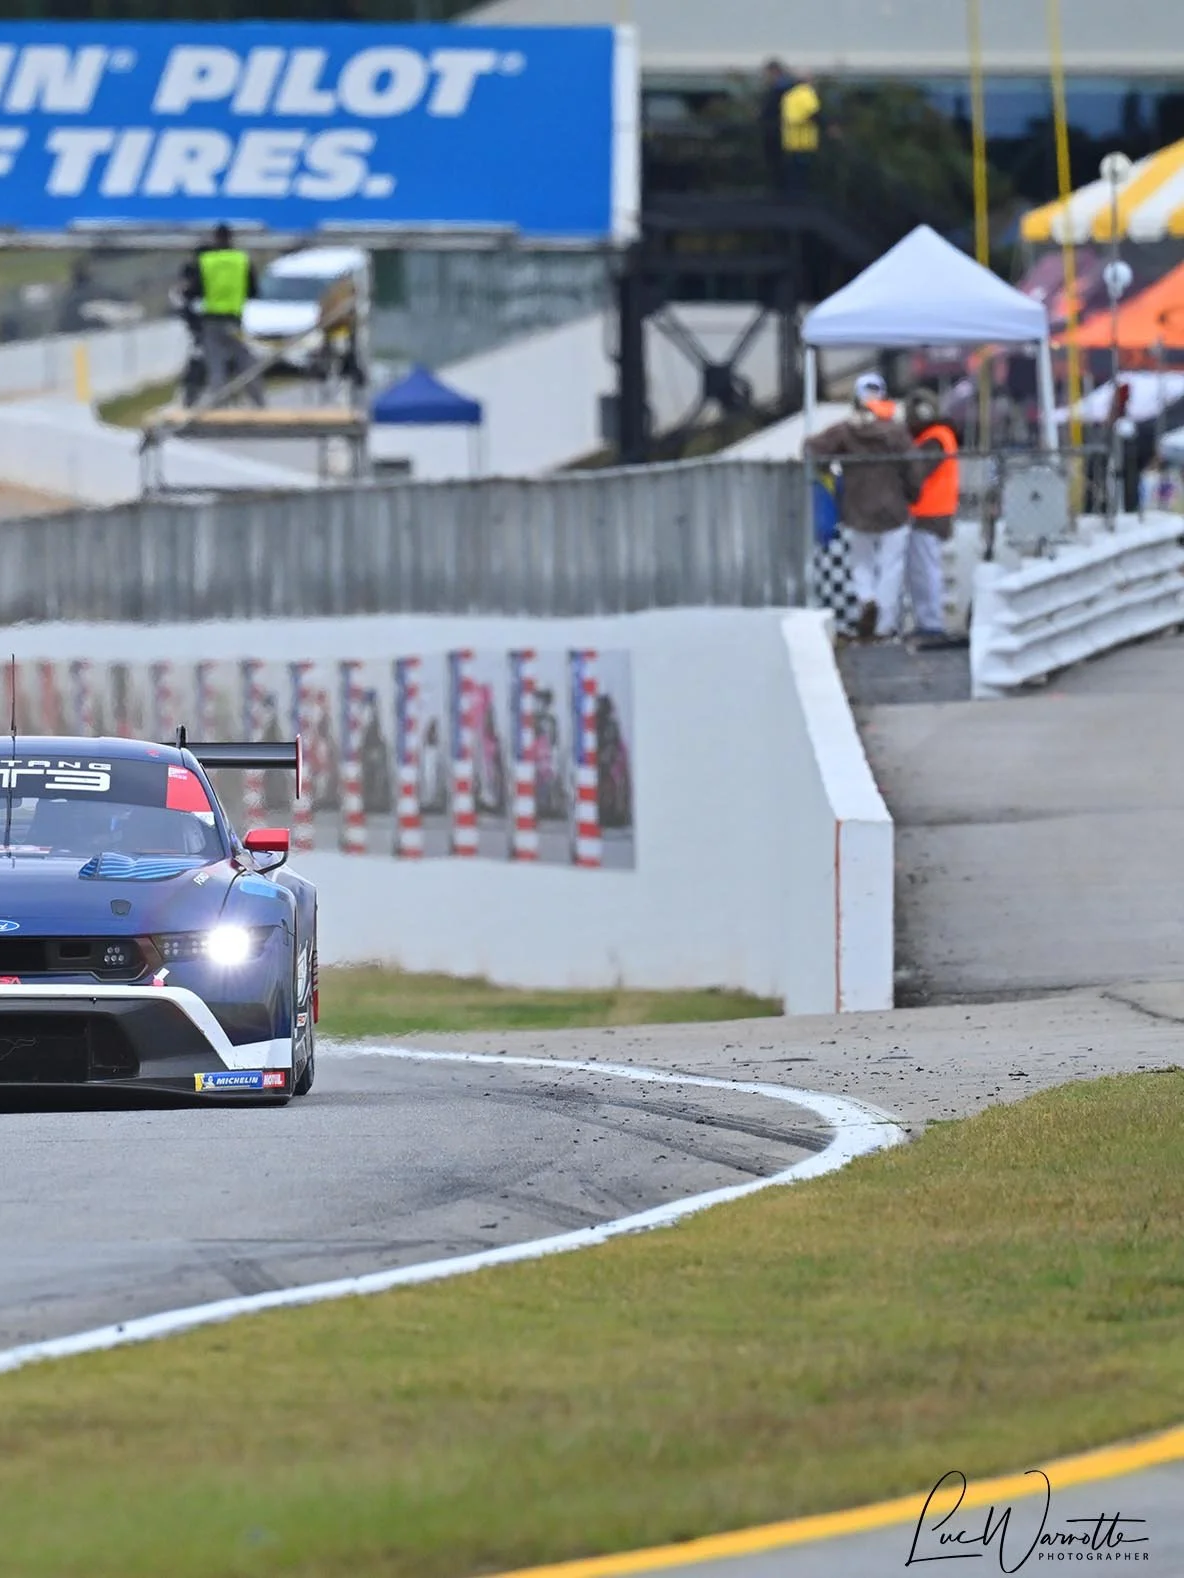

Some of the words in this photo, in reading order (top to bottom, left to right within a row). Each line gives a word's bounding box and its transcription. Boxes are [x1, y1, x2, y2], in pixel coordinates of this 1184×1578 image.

[150, 45, 498, 117] PILOT
[44, 127, 397, 199] TIRES.
[216, 1076, 259, 1086] MICHELIN
